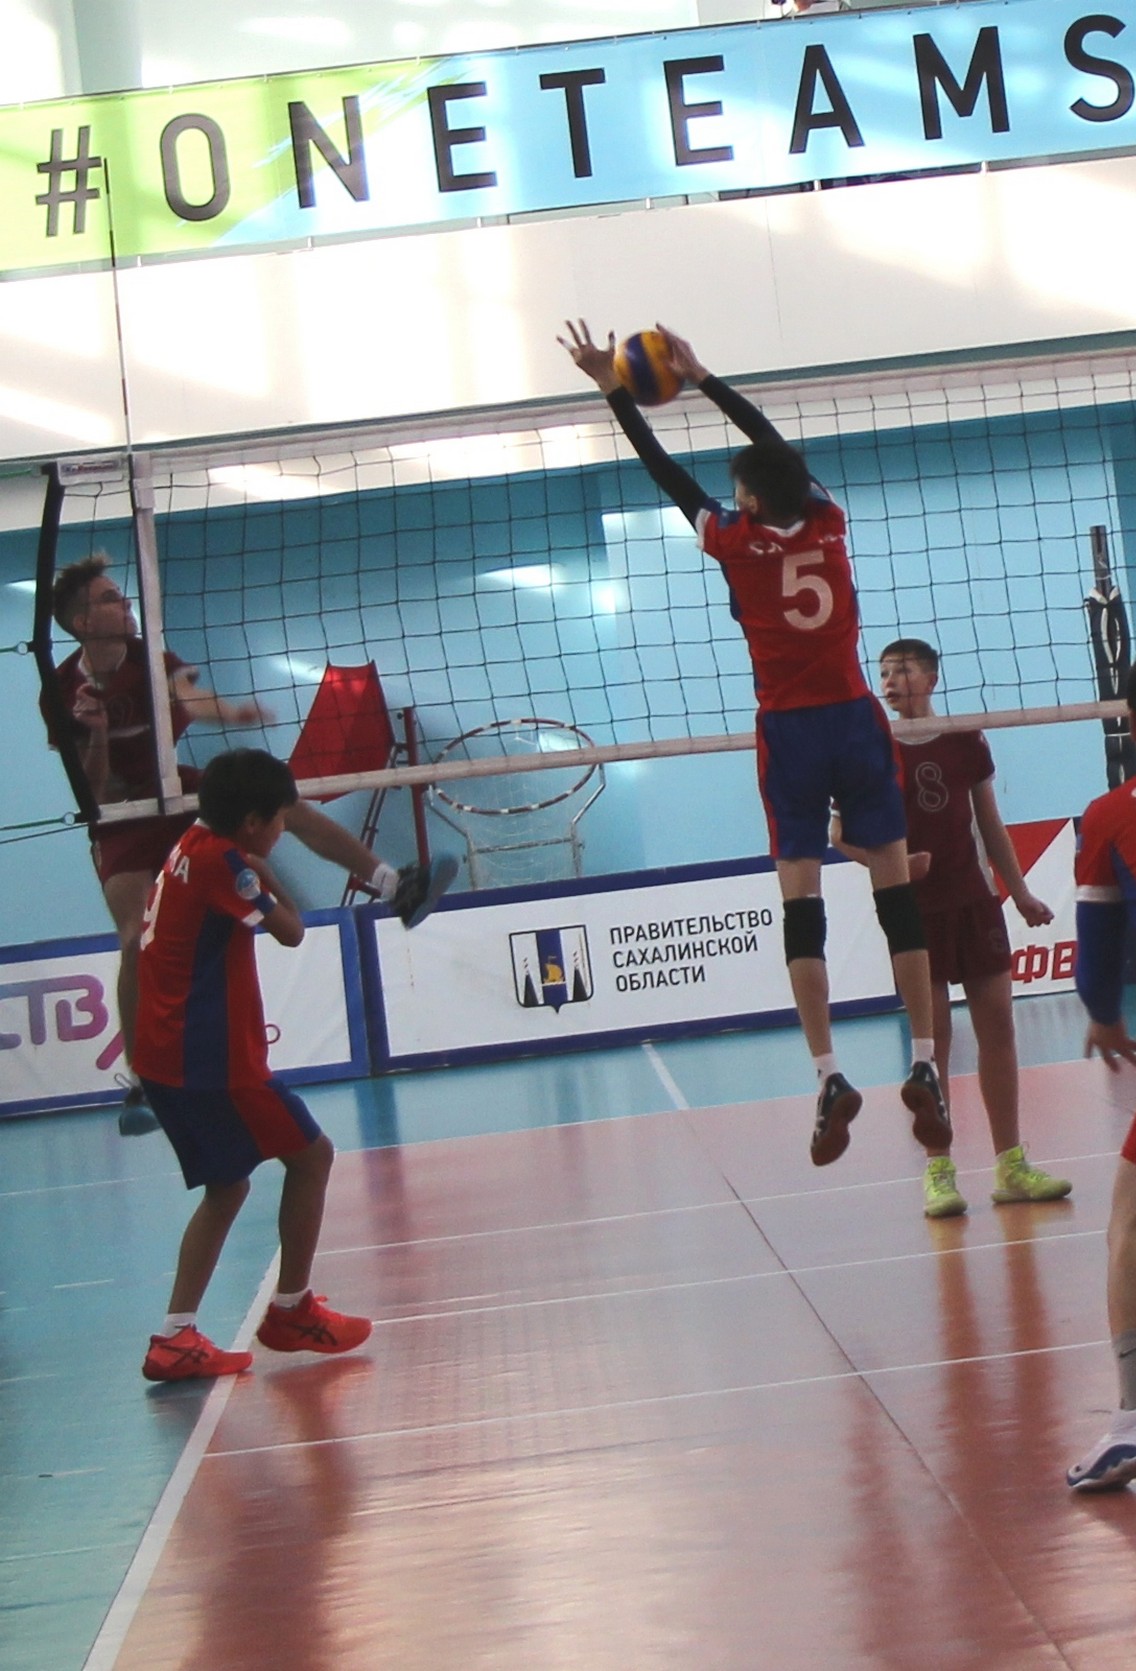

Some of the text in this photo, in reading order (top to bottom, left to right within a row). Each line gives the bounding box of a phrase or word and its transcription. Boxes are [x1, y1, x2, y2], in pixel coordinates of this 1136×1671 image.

[782, 550, 833, 631] 5
[915, 761, 949, 812] 8
[609, 908, 773, 946] ПРАВИТЕЛЬСТВО
[613, 930, 758, 968] САХАЛИНСКОЙ
[616, 965, 706, 992] ОБЛАСТИ
